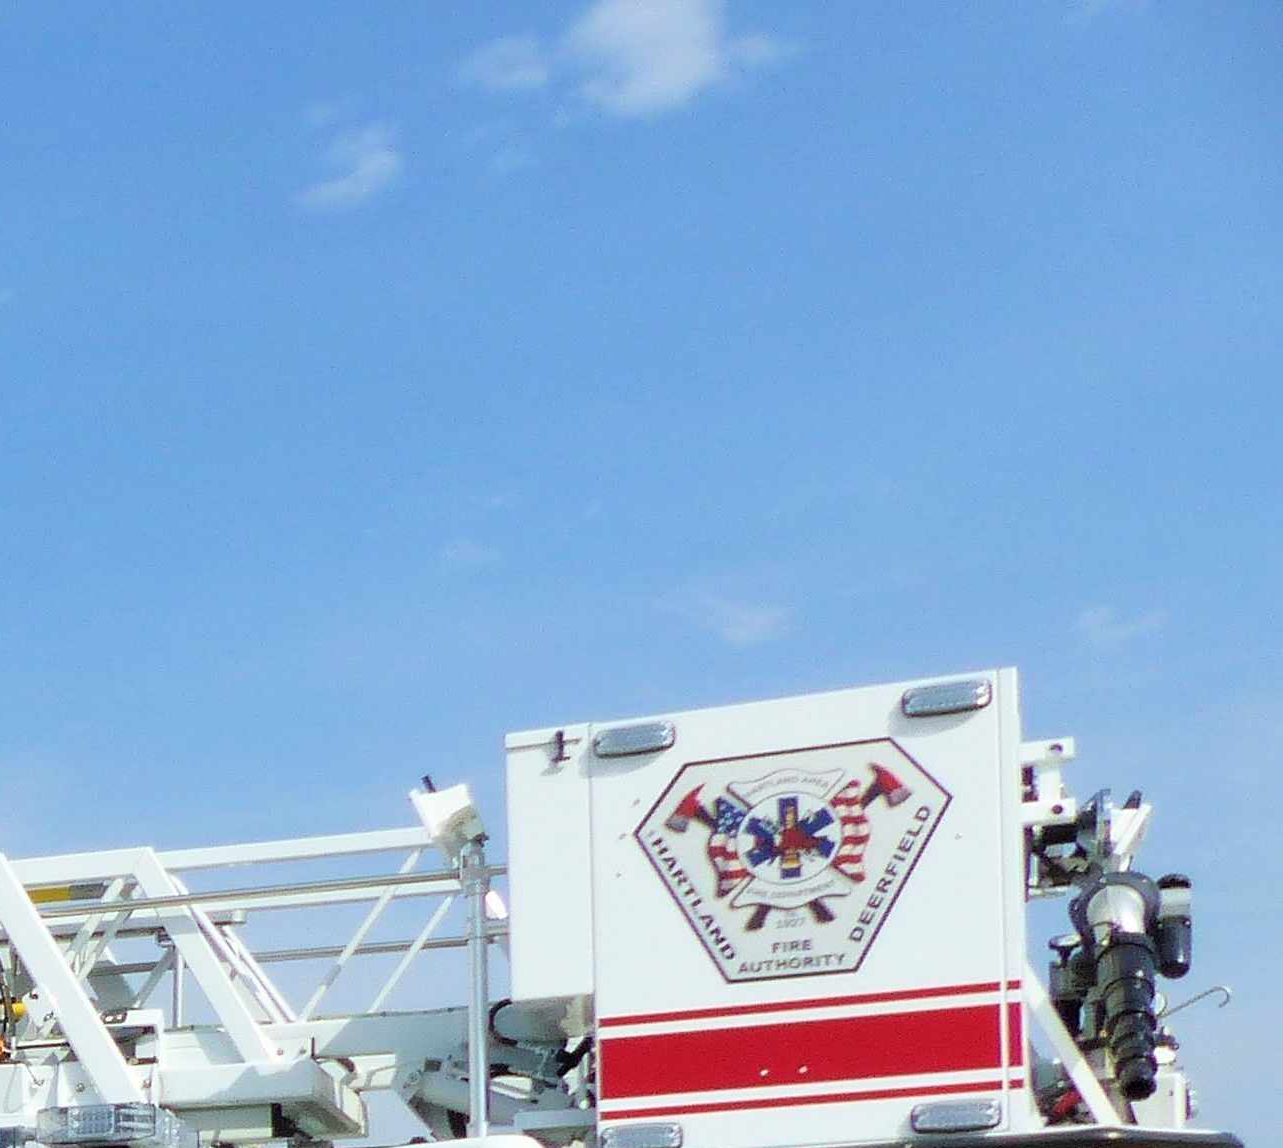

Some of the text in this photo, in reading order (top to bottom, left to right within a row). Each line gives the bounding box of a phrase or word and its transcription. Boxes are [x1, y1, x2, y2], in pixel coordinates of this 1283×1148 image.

[651, 836, 735, 961] HARTLAND
[848, 805, 931, 943] DEERFIELD
[737, 953, 845, 973] AUTHORITY
[771, 939, 813, 954] FIRE
